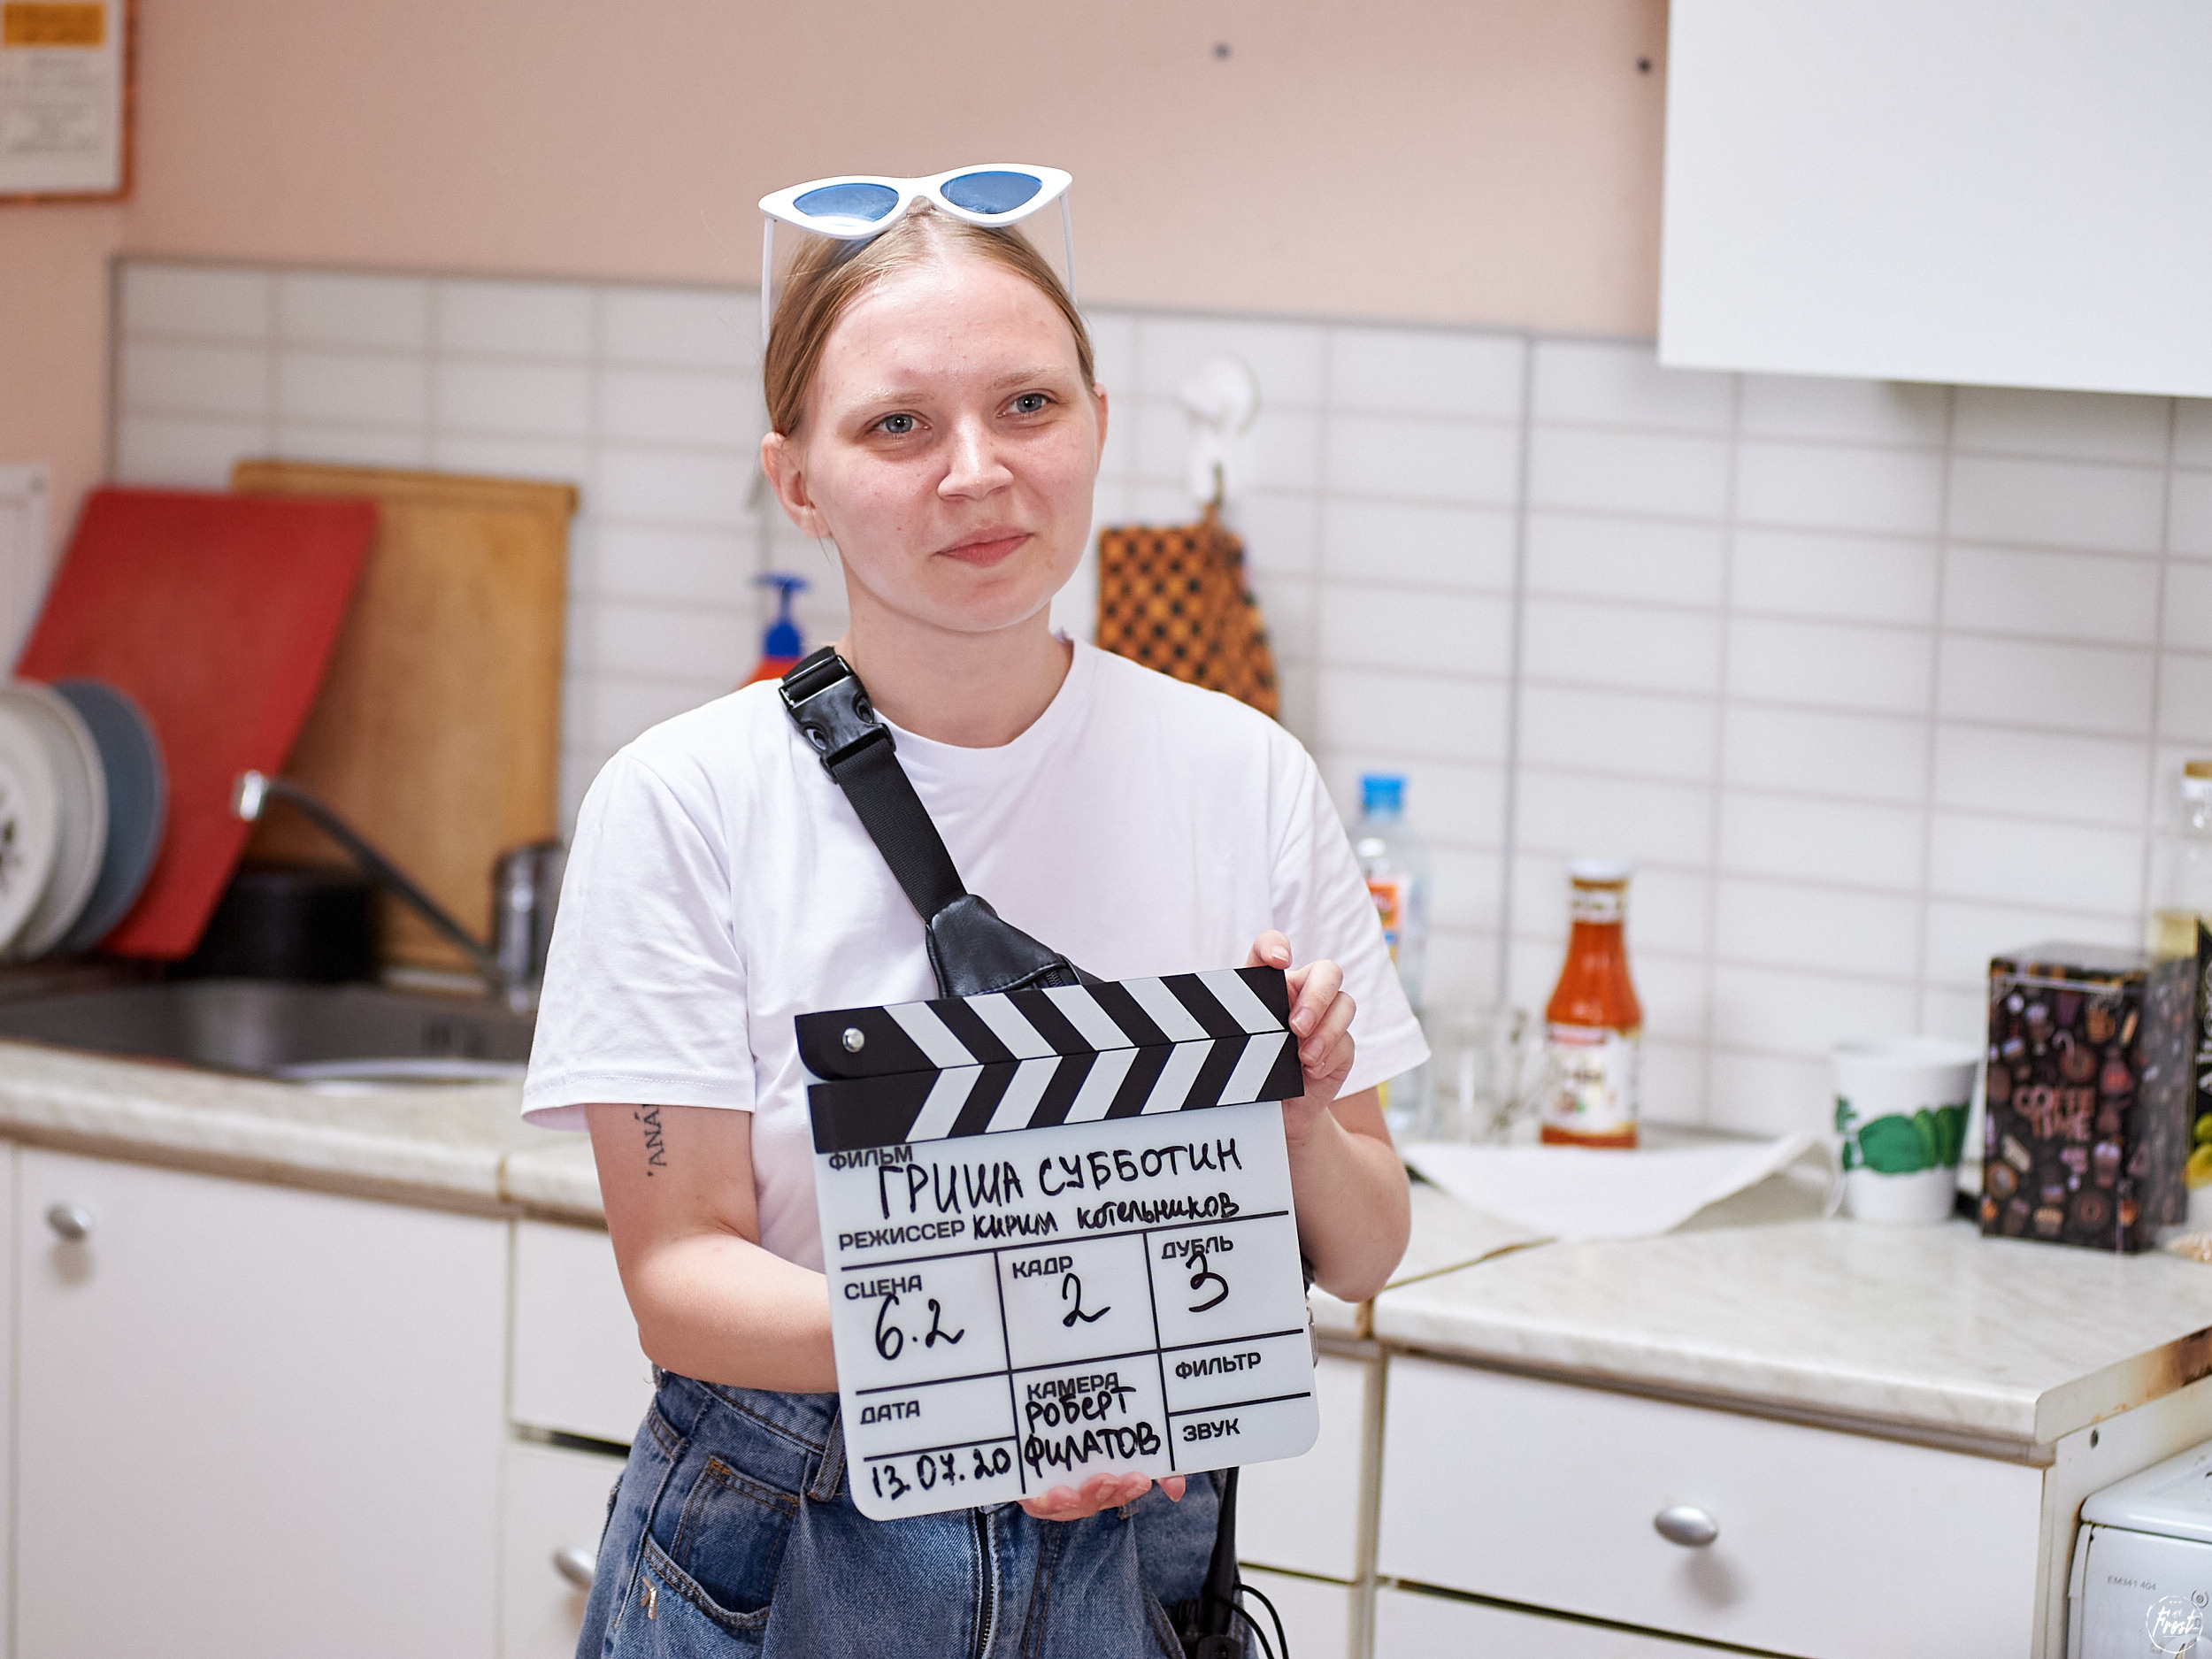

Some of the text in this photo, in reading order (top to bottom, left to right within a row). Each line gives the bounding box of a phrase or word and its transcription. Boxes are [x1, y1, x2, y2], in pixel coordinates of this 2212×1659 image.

[828, 1145, 913, 1171] ФИЛЬМ
[879, 1138, 1242, 1219] ГРИША СУББОТИН
[839, 1219, 965, 1251] РЕЖИССЕР
[1161, 1235, 1234, 1260] ДУБЛЬ
[1012, 1256, 1073, 1279] КАДР
[1185, 1250, 1229, 1313] 3
[844, 1275, 922, 1301] СЦЕНА
[1062, 1273, 1110, 1326] 2
[875, 1294, 965, 1361] 6.2
[1175, 1351, 1262, 1379] ФИЛЬТР
[1027, 1371, 1119, 1401] КАМЕРА
[860, 1401, 921, 1425] ДАТА
[1183, 1417, 1240, 1443] ЗВУК
[1025, 1422, 1161, 1479] ФИЛАТОВ
